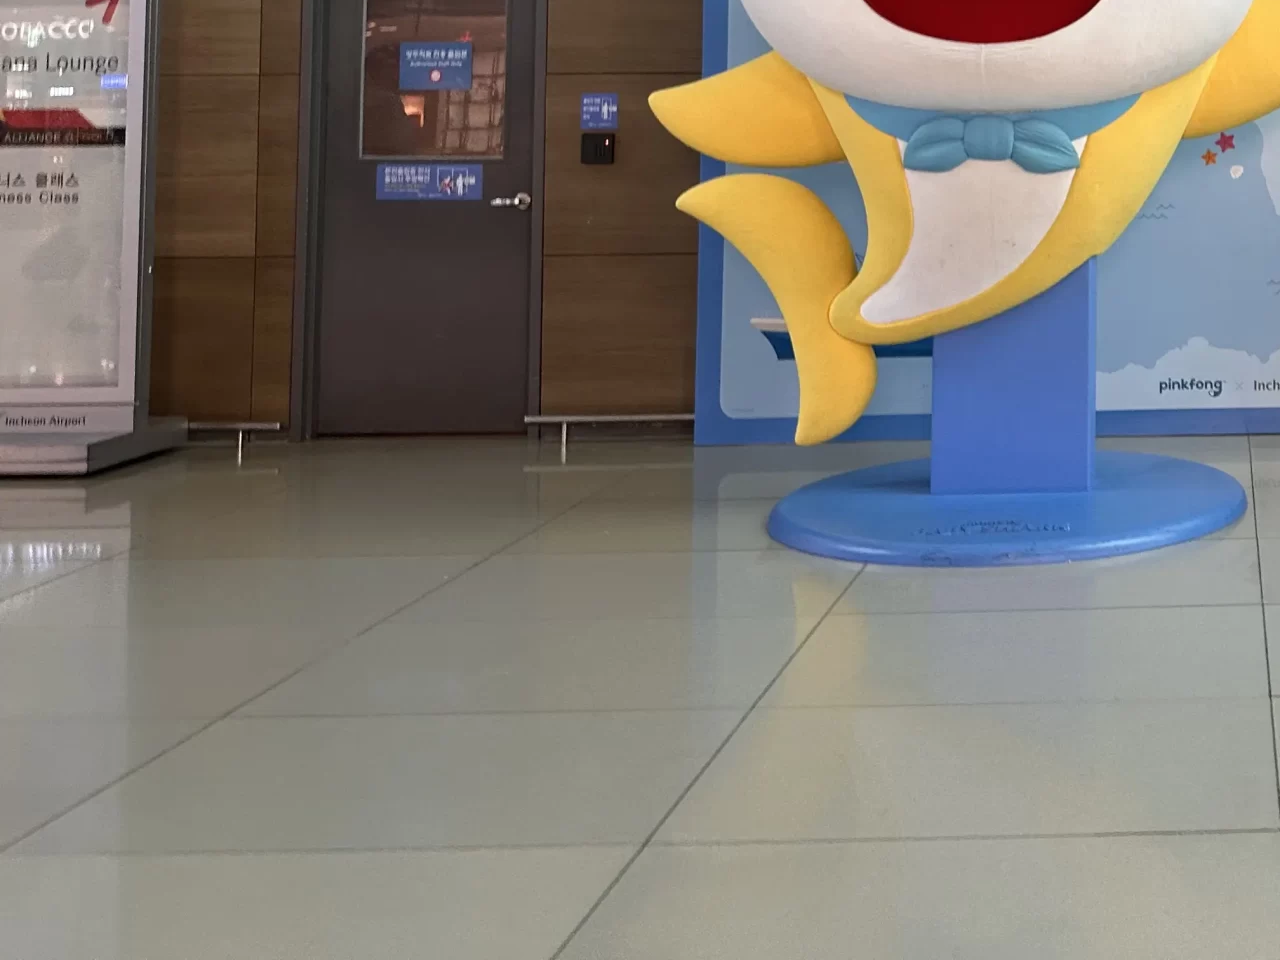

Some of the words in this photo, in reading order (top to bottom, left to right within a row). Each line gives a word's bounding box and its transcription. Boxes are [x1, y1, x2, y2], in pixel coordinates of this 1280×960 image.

[2, 55, 37, 72] ana
[46, 52, 119, 75] Lounge
[0, 192, 31, 204] ness
[1159, 377, 1223, 397] pinkfong
[5, 416, 46, 427] Incheon
[50, 415, 87, 428] Airport
